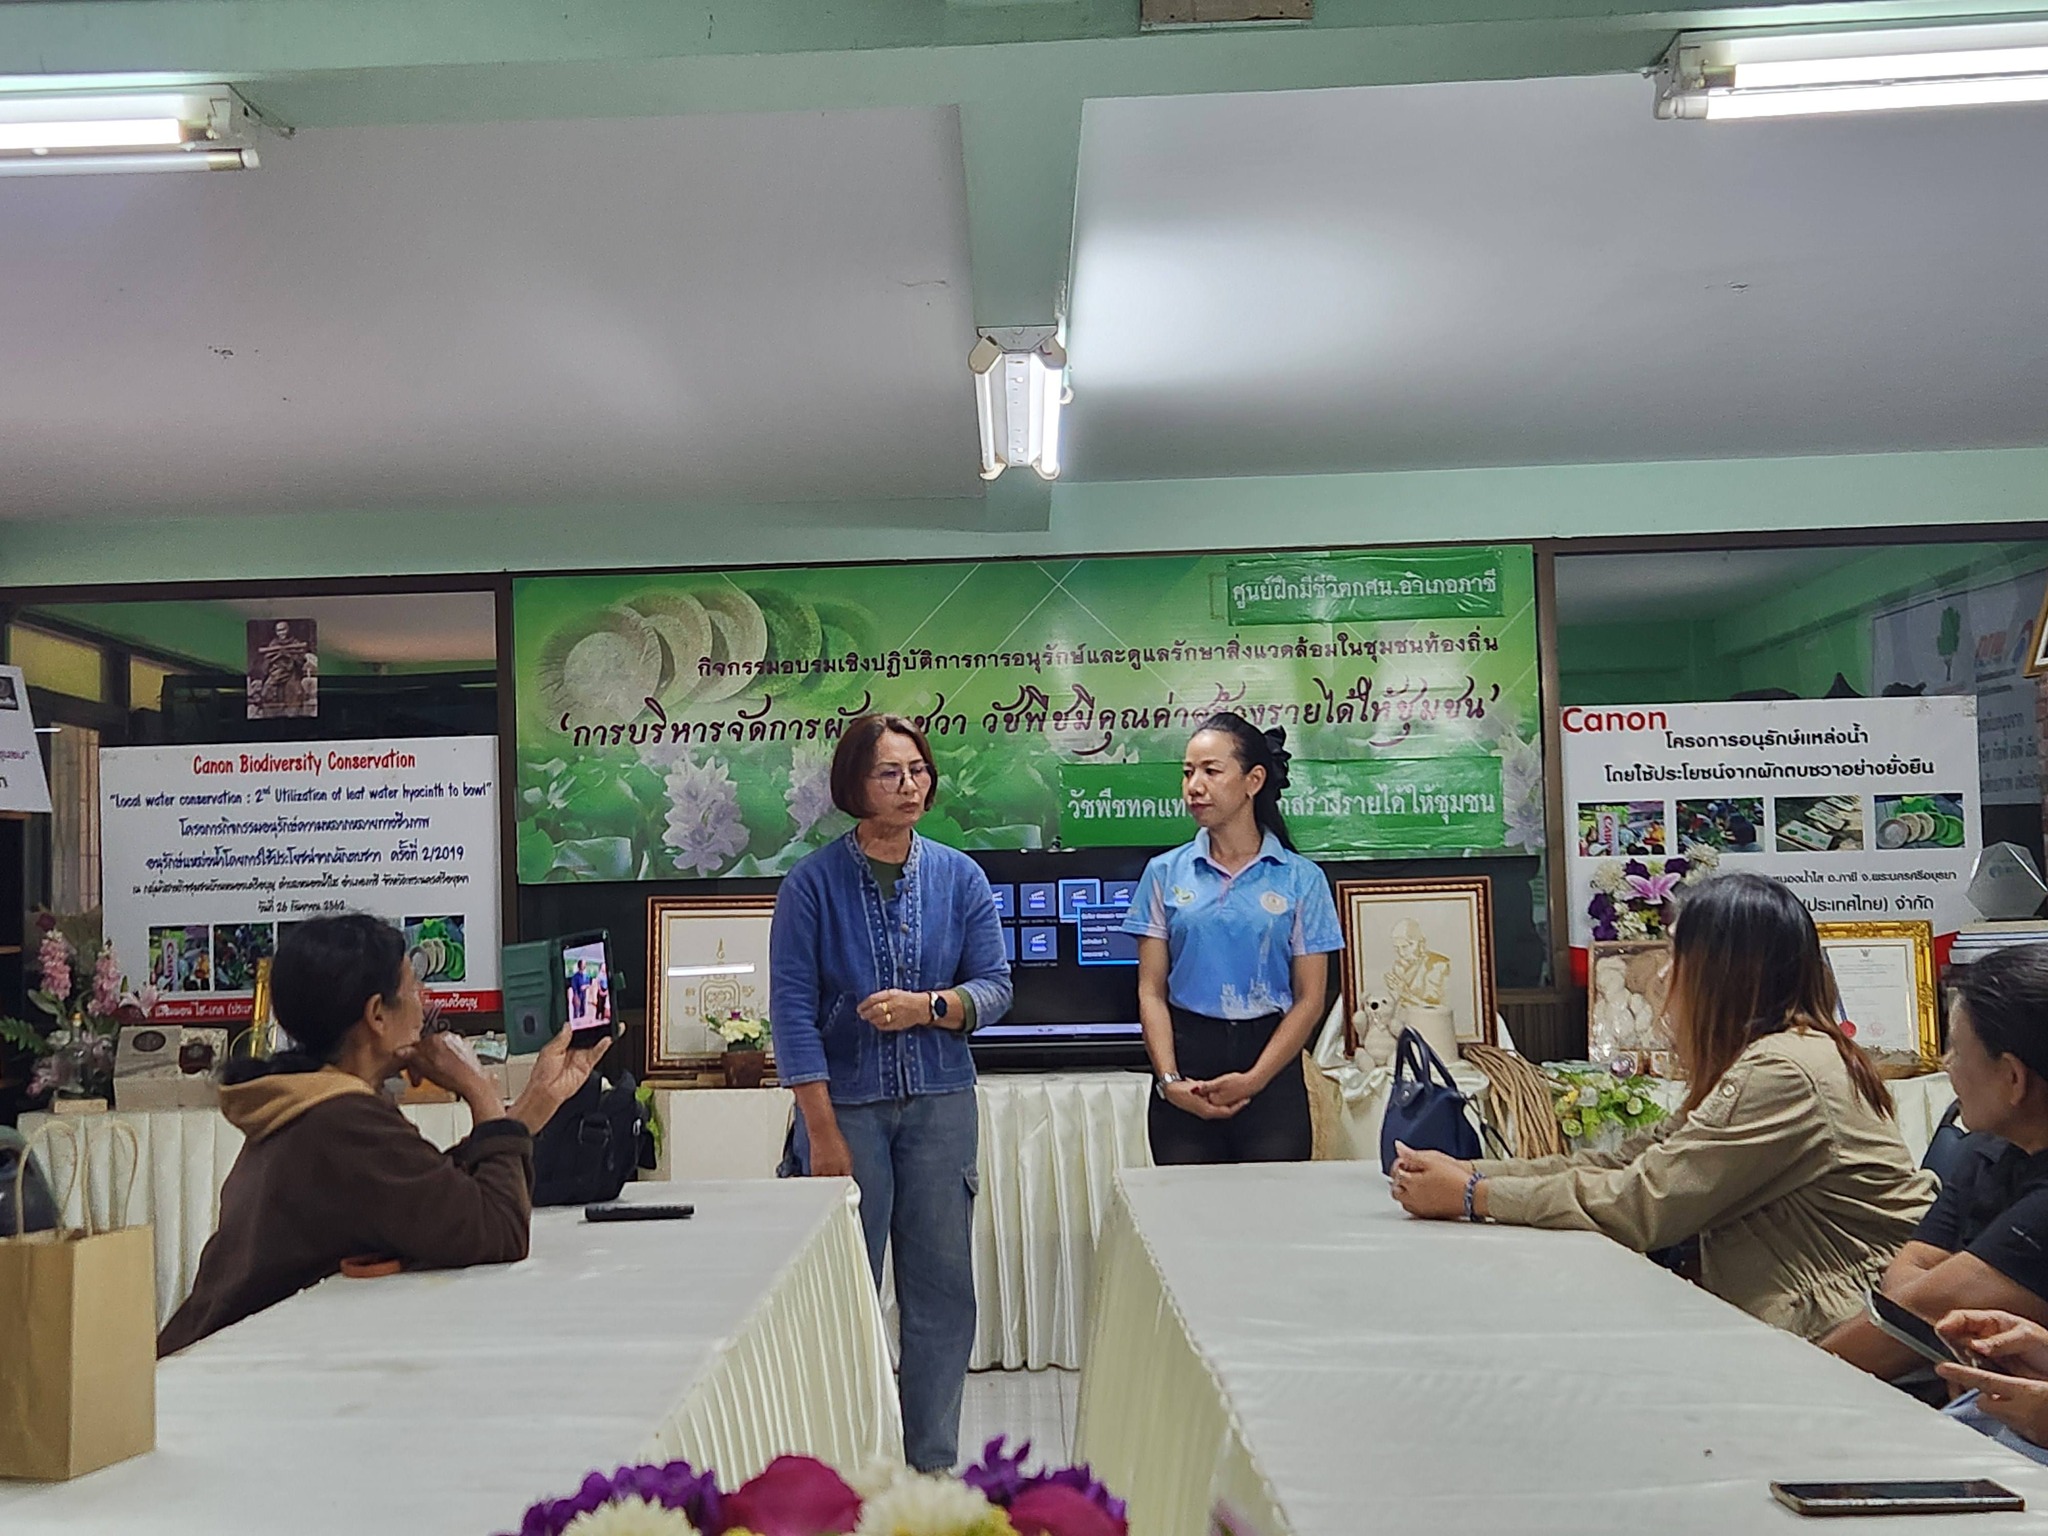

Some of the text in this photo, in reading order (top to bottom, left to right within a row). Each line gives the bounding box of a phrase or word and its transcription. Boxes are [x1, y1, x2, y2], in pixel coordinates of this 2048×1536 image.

[1563, 707, 1667, 733] Canon
[1665, 724, 1869, 751] โครงการอนุรักษ์แหล่งน้ำ
[193, 748, 416, 776] Canon Biodiversity Conservation
[1604, 754, 1935, 783] โดยใช้ประโยชน์จากผักตบชวาอย่างยั่งยืน
[146, 791, 175, 807] water
[179, 790, 242, 806] conservation
[275, 786, 328, 803] Utilization
[331, 786, 342, 800] of
[369, 784, 399, 799] water
[402, 782, 444, 802] hyacinth
[448, 782, 459, 797] to
[423, 846, 465, 863] 2/2019
[1895, 895, 1934, 910] จำกัด
